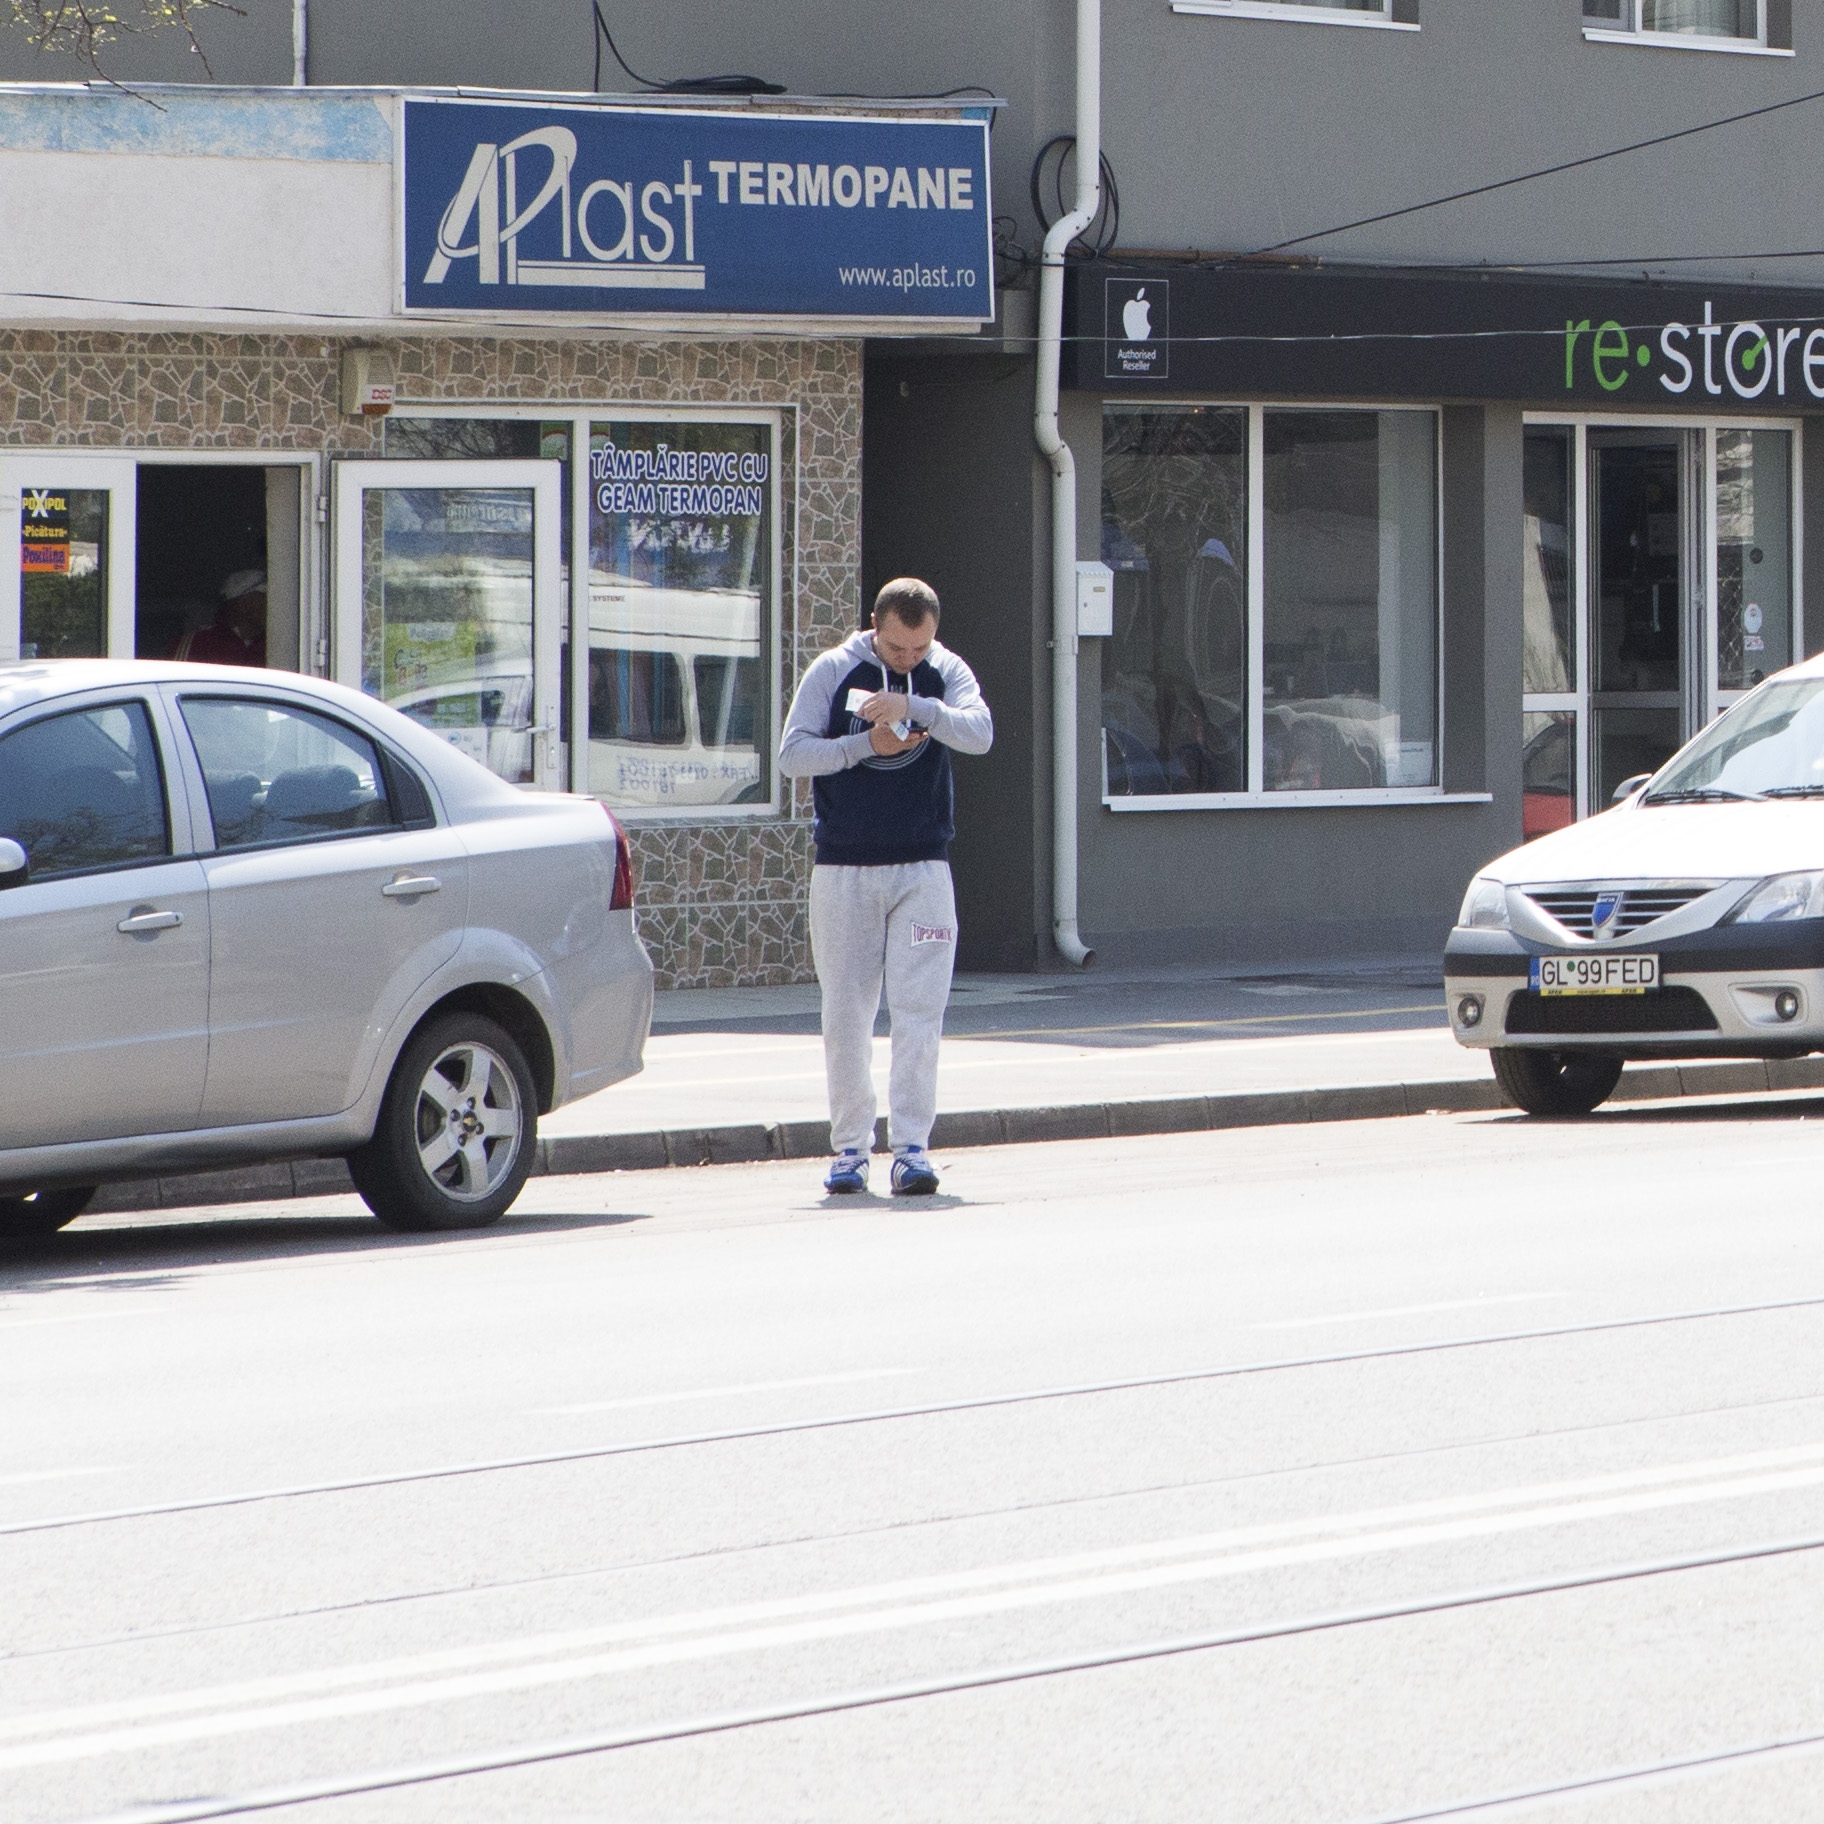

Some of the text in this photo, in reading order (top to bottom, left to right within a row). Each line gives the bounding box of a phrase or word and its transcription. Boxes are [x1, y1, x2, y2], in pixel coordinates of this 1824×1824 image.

[709, 161, 974, 210] TERMOPANE
[838, 262, 976, 294] www.aplast.ro
[1117, 348, 1157, 360] Authorised
[1122, 359, 1151, 371] Reseller
[591, 442, 768, 483] TÂMPLĂRIE PVC CU
[597, 483, 762, 515] GEAM TERMOPAN
[1541, 960, 1569, 986] GL
